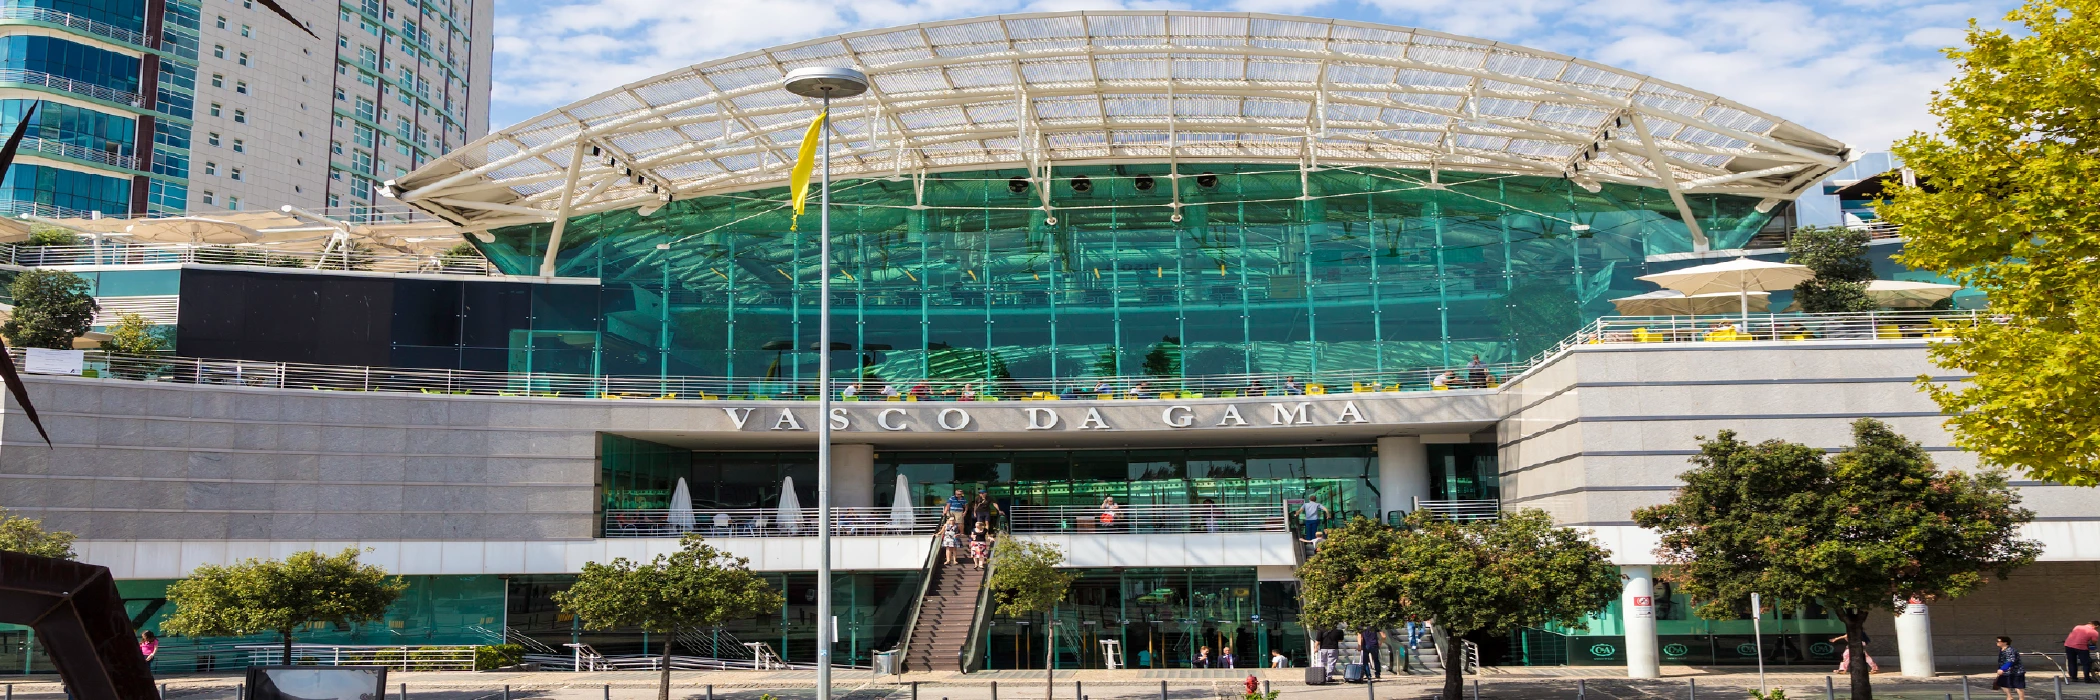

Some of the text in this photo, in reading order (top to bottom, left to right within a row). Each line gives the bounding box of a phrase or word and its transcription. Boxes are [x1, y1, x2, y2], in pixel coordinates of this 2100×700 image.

[723, 400, 1369, 431] VASCO DA GAMA
